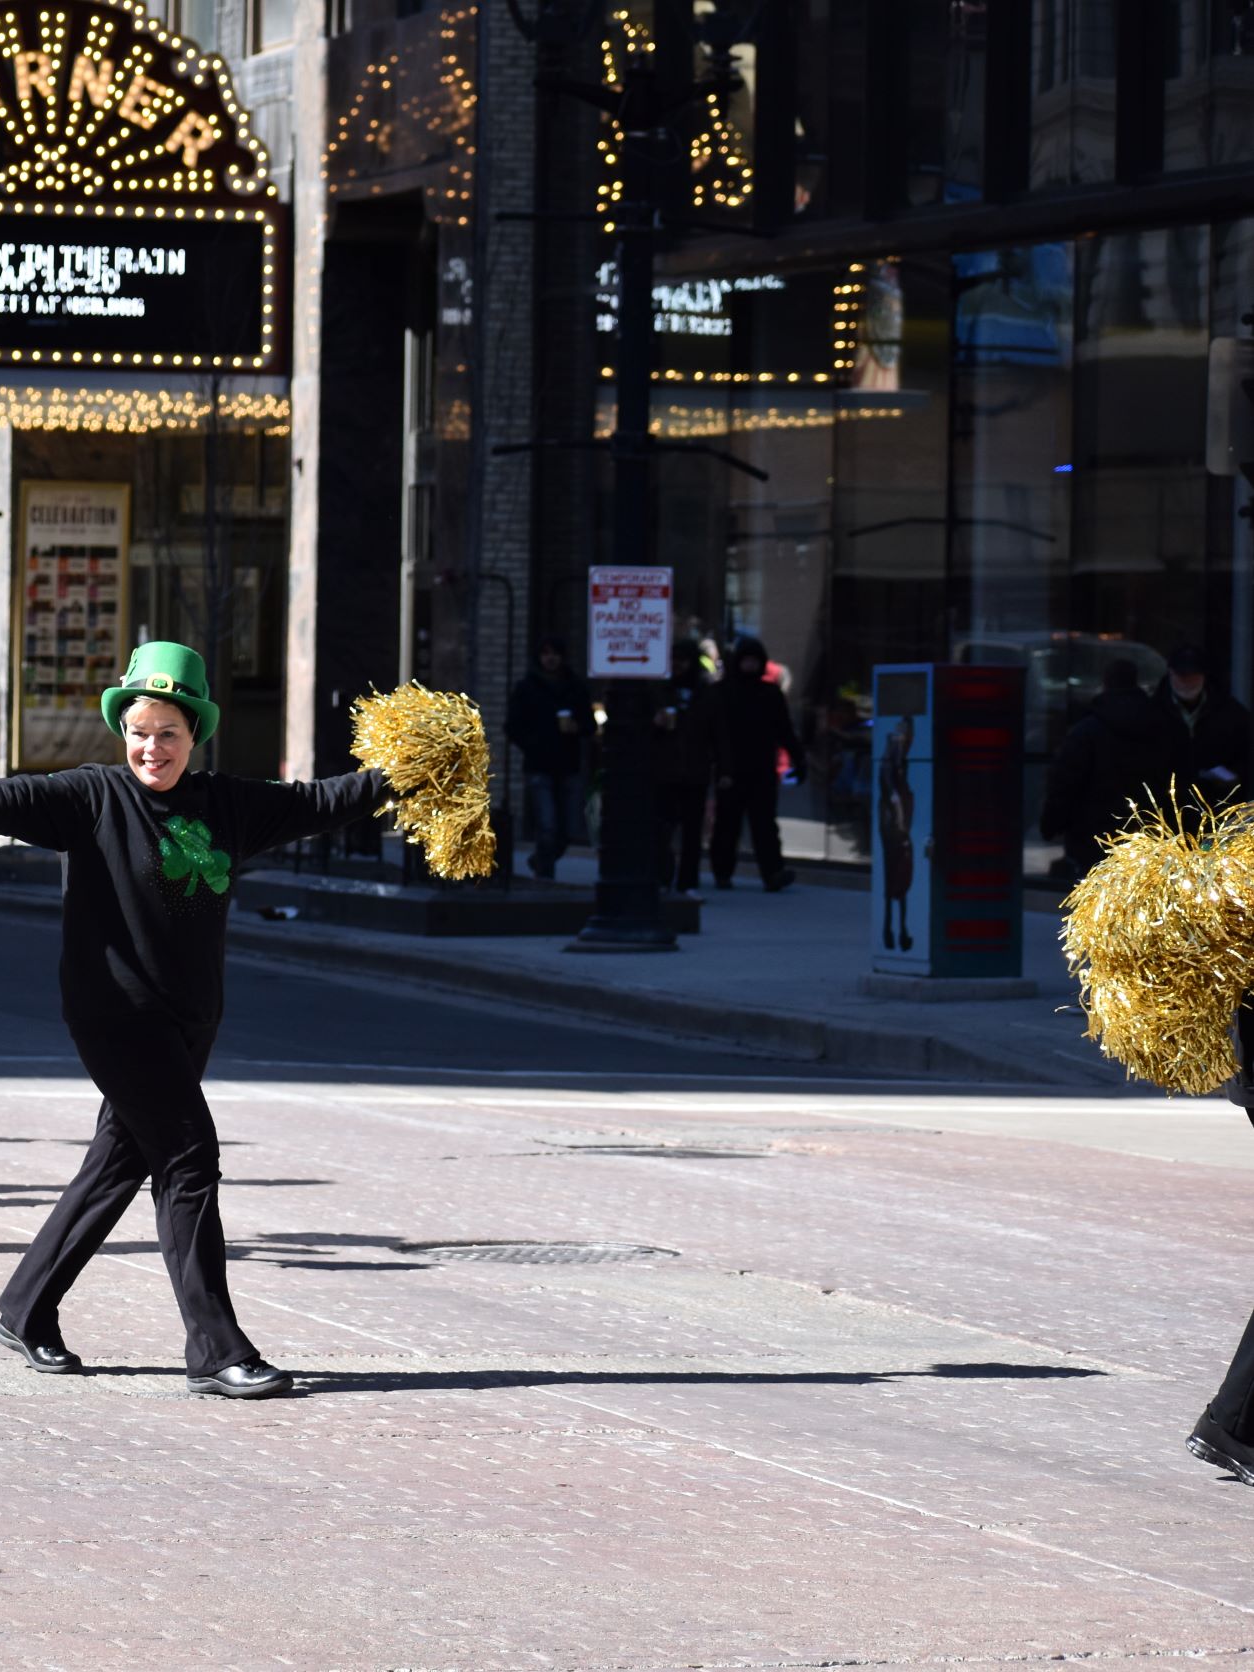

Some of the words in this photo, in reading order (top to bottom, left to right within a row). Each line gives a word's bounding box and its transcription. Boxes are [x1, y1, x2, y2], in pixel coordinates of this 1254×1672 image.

[115, 247, 186, 275] RAIN
[31, 505, 117, 524] CELEBRATION
[598, 573, 663, 583] TEMPORARY
[619, 599, 642, 611] NO
[595, 611, 664, 625] PARKING
